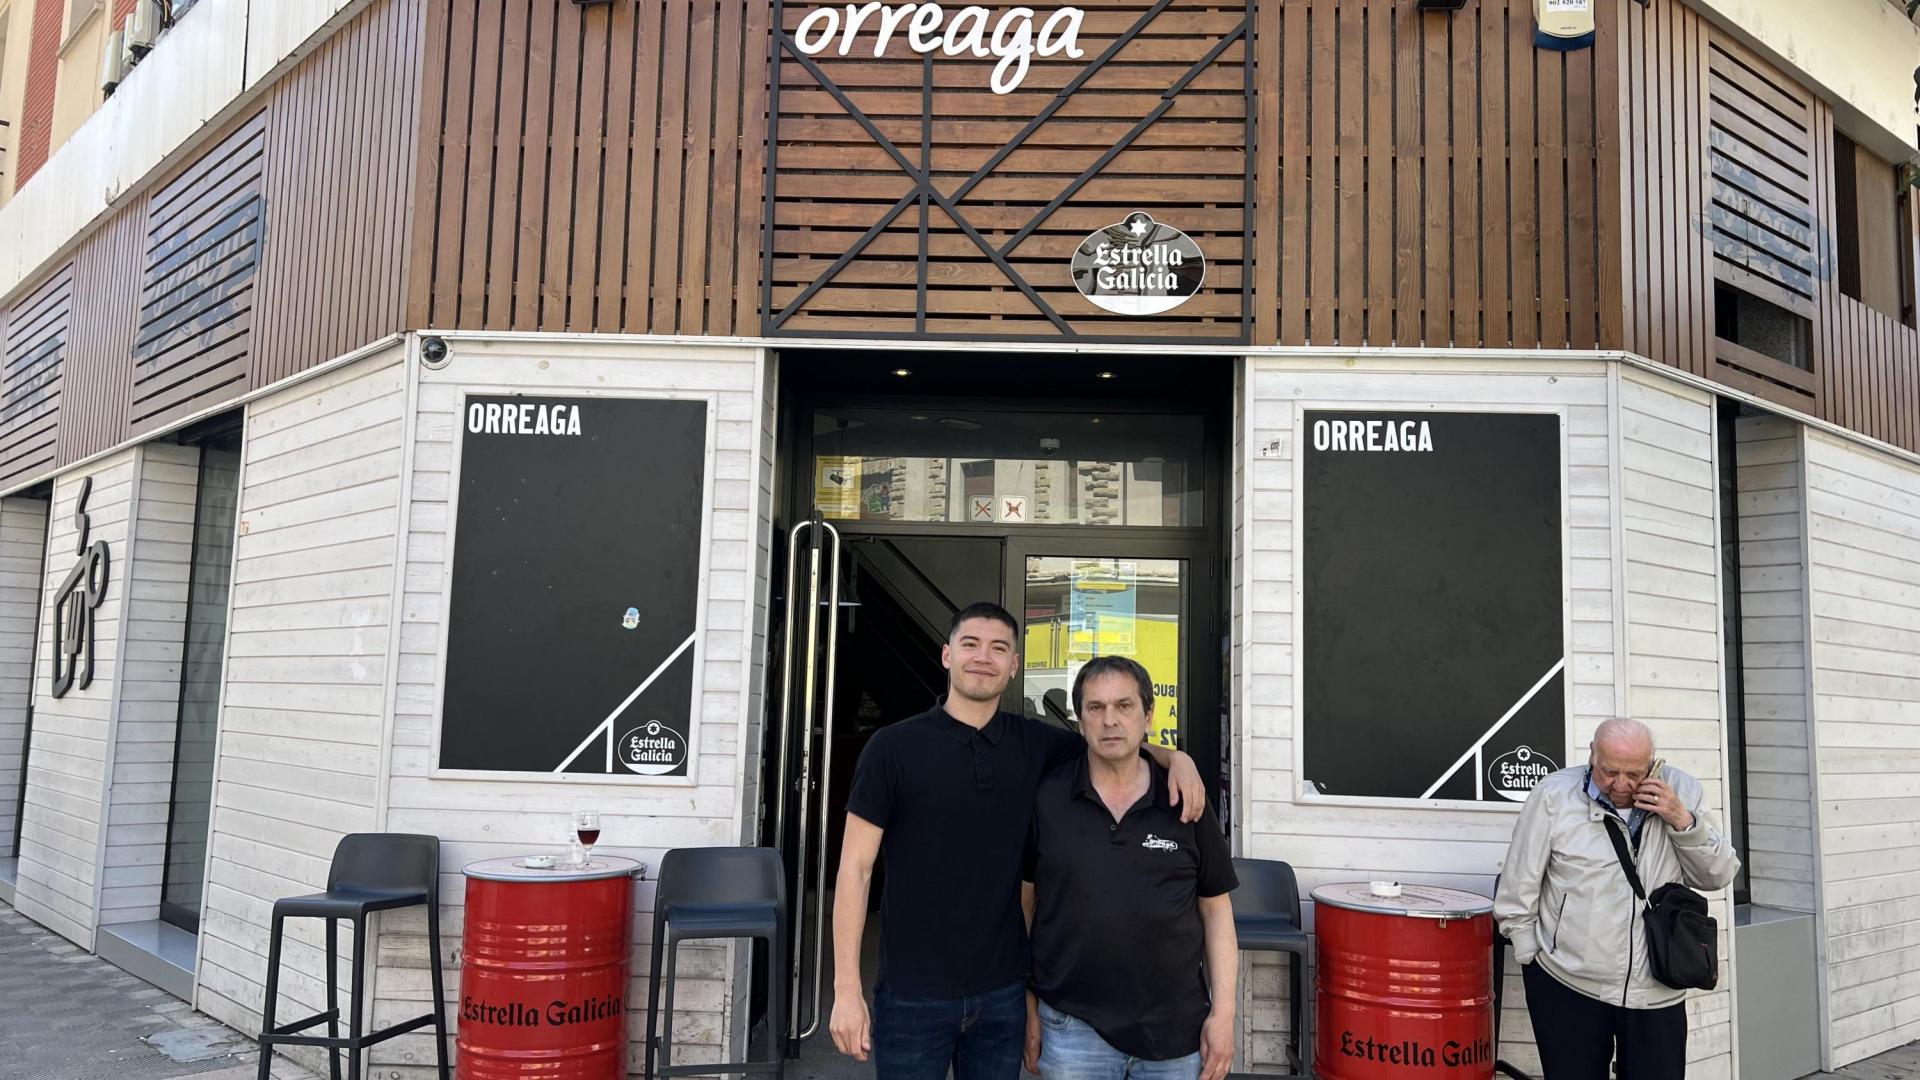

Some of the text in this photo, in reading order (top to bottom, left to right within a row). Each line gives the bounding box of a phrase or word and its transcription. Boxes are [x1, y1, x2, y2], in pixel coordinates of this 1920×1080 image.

[795, 1, 1084, 95] orreaga
[1093, 242, 1183, 266] Estrella
[1096, 266, 1179, 290] Galicia
[468, 403, 581, 436] ORREAGA
[1313, 420, 1433, 452] ORREAGA
[629, 736, 676, 750] Estrella
[631, 749, 673, 762] Galicia
[1500, 761, 1548, 776] Estrella
[1502, 774, 1541, 789] Galici
[464, 993, 621, 1027] Estrella Galicia
[1339, 1029, 1436, 1068] Estrella
